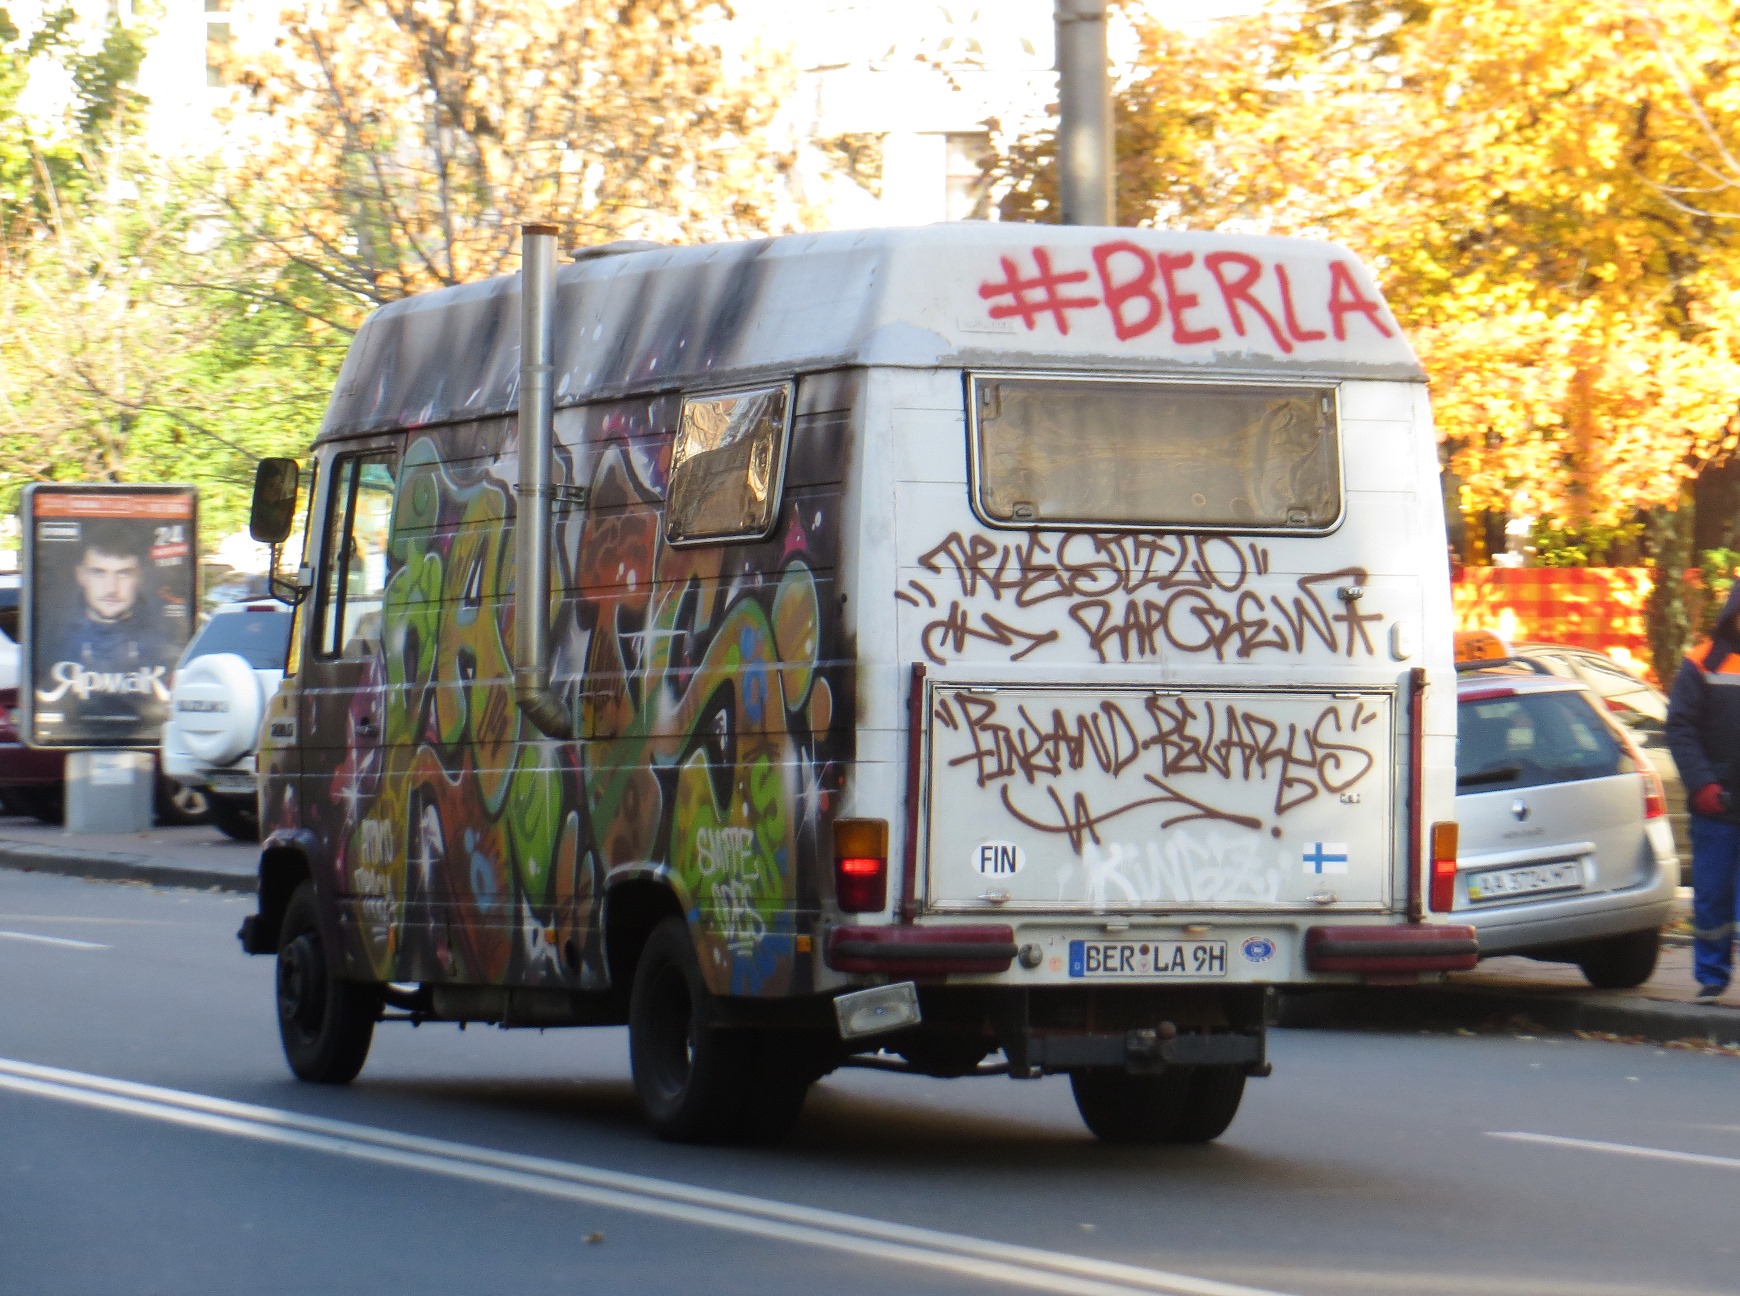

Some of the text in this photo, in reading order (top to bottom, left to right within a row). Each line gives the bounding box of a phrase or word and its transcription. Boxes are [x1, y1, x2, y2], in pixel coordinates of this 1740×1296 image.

[978, 239, 1393, 354] #BERLA
[980, 844, 1017, 874] FIN
[1085, 945, 1135, 973] BER
[1153, 945, 1186, 972] LA
[1192, 945, 1225, 973] 9H
